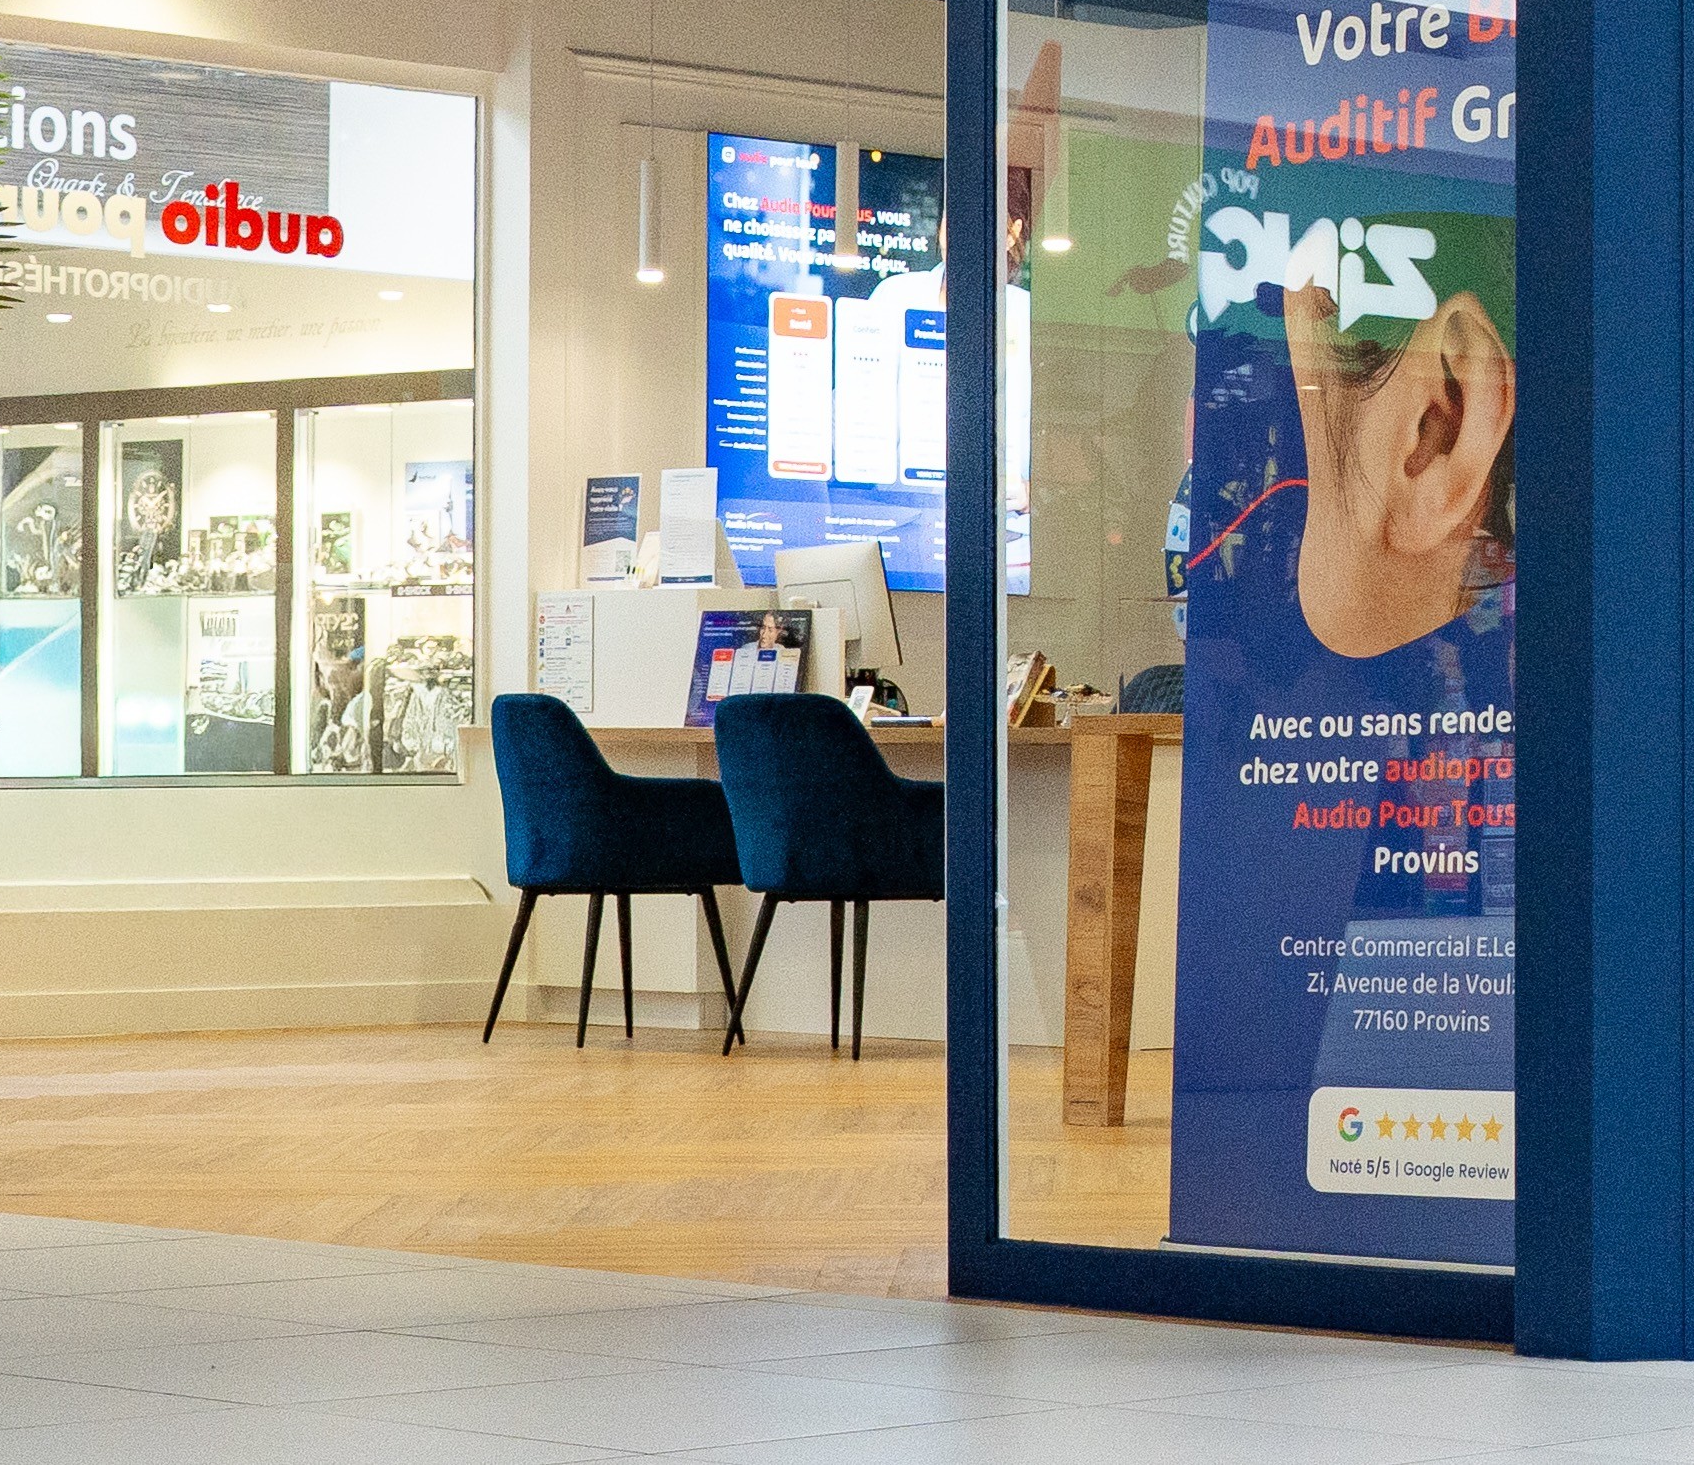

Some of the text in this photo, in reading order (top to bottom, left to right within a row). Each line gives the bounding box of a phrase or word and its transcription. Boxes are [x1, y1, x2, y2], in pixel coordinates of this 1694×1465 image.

[1296, 2, 1450, 67] Votre
[1245, 87, 1439, 171] Auditif
[723, 192, 759, 212] Chez
[760, 195, 801, 215] Audio
[876, 211, 911, 228] vous
[723, 219, 742, 233] ne
[884, 231, 912, 255] prix
[913, 237, 929, 252] et
[723, 241, 777, 261] qualité.
[1249, 703, 1515, 741] Avec ou sans rende
[1240, 757, 1299, 786] chez
[1306, 757, 1380, 784] votre
[1292, 798, 1515, 831] Audio Pour Tous
[1373, 842, 1479, 875] Provins
[1280, 935, 1347, 958] Centre
[1351, 934, 1471, 958] Commercial
[1307, 972, 1515, 996] Zi, Avenue de la Voul
[1353, 1008, 1490, 1033] 77160 Provins
[1329, 1156, 1510, 1182] Noté 5/5 Google Review
